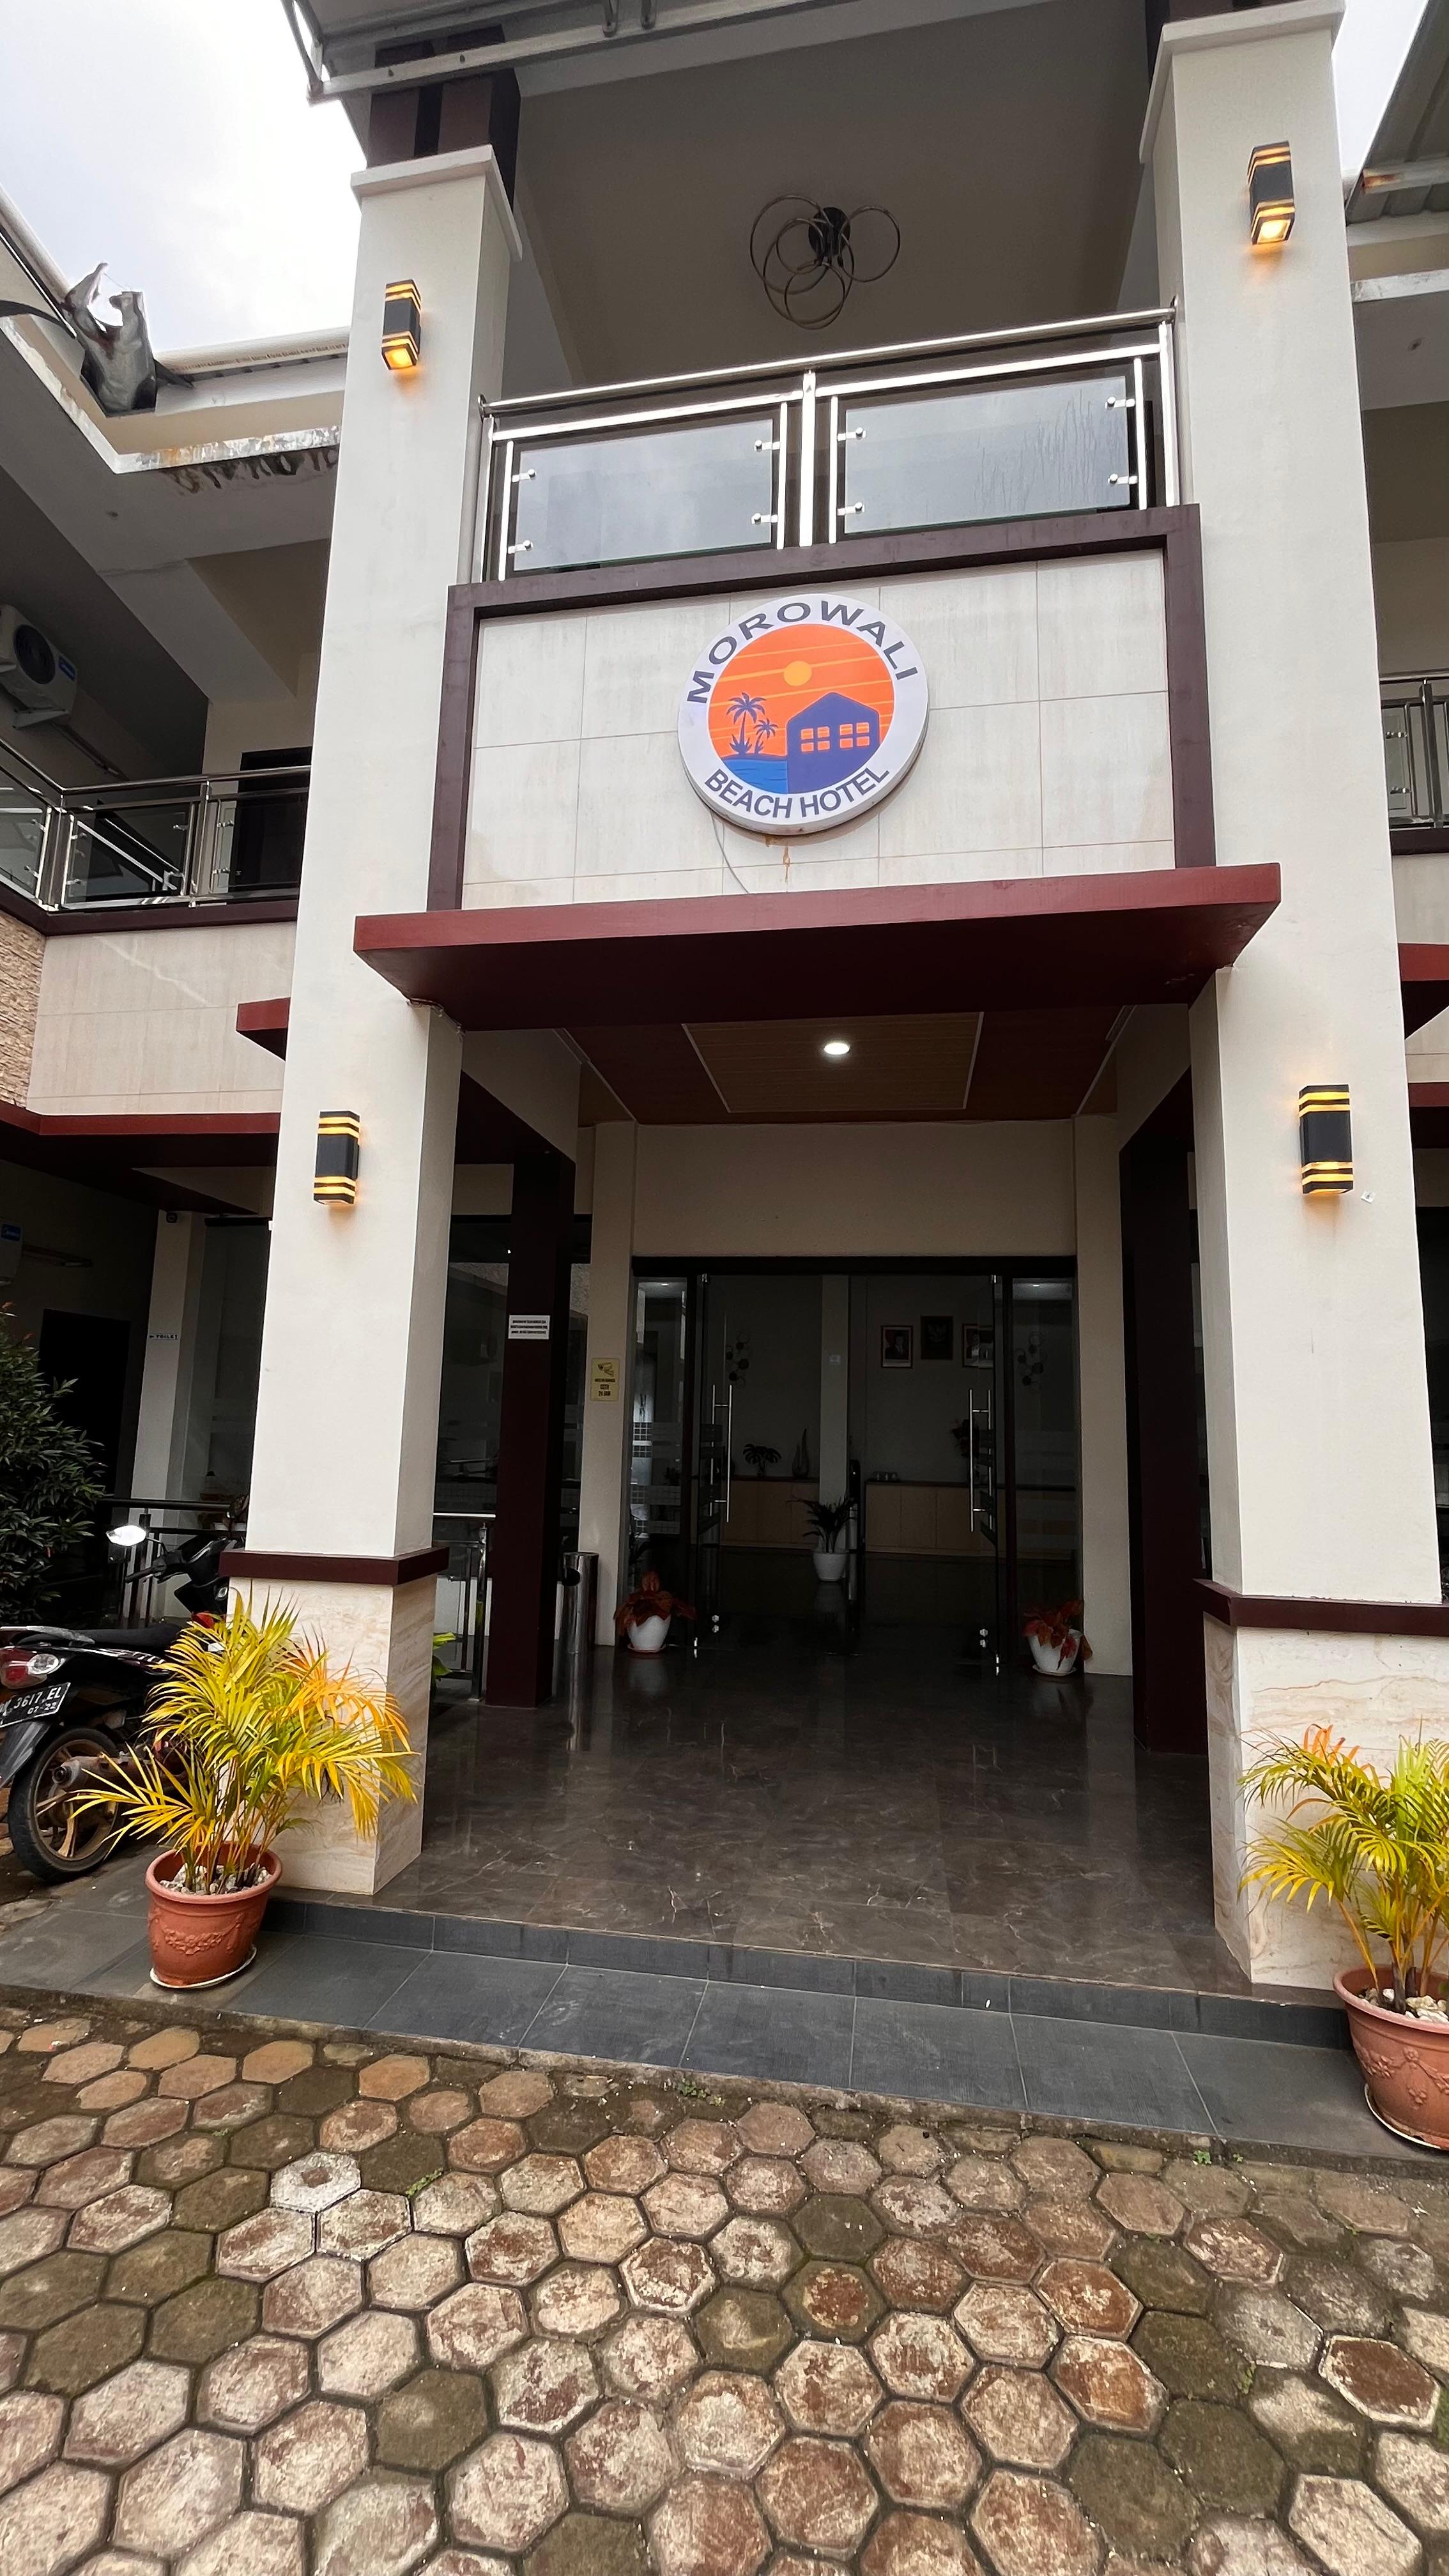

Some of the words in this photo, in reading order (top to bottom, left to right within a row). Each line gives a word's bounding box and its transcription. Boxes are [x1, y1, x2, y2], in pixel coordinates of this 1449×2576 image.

[687, 601, 918, 704] MOROWALI
[704, 769, 793, 818] BEACH
[800, 767, 890, 818] HOTEL
[13, 1691, 43, 1709] 3617
[47, 1687, 62, 1699] EL
